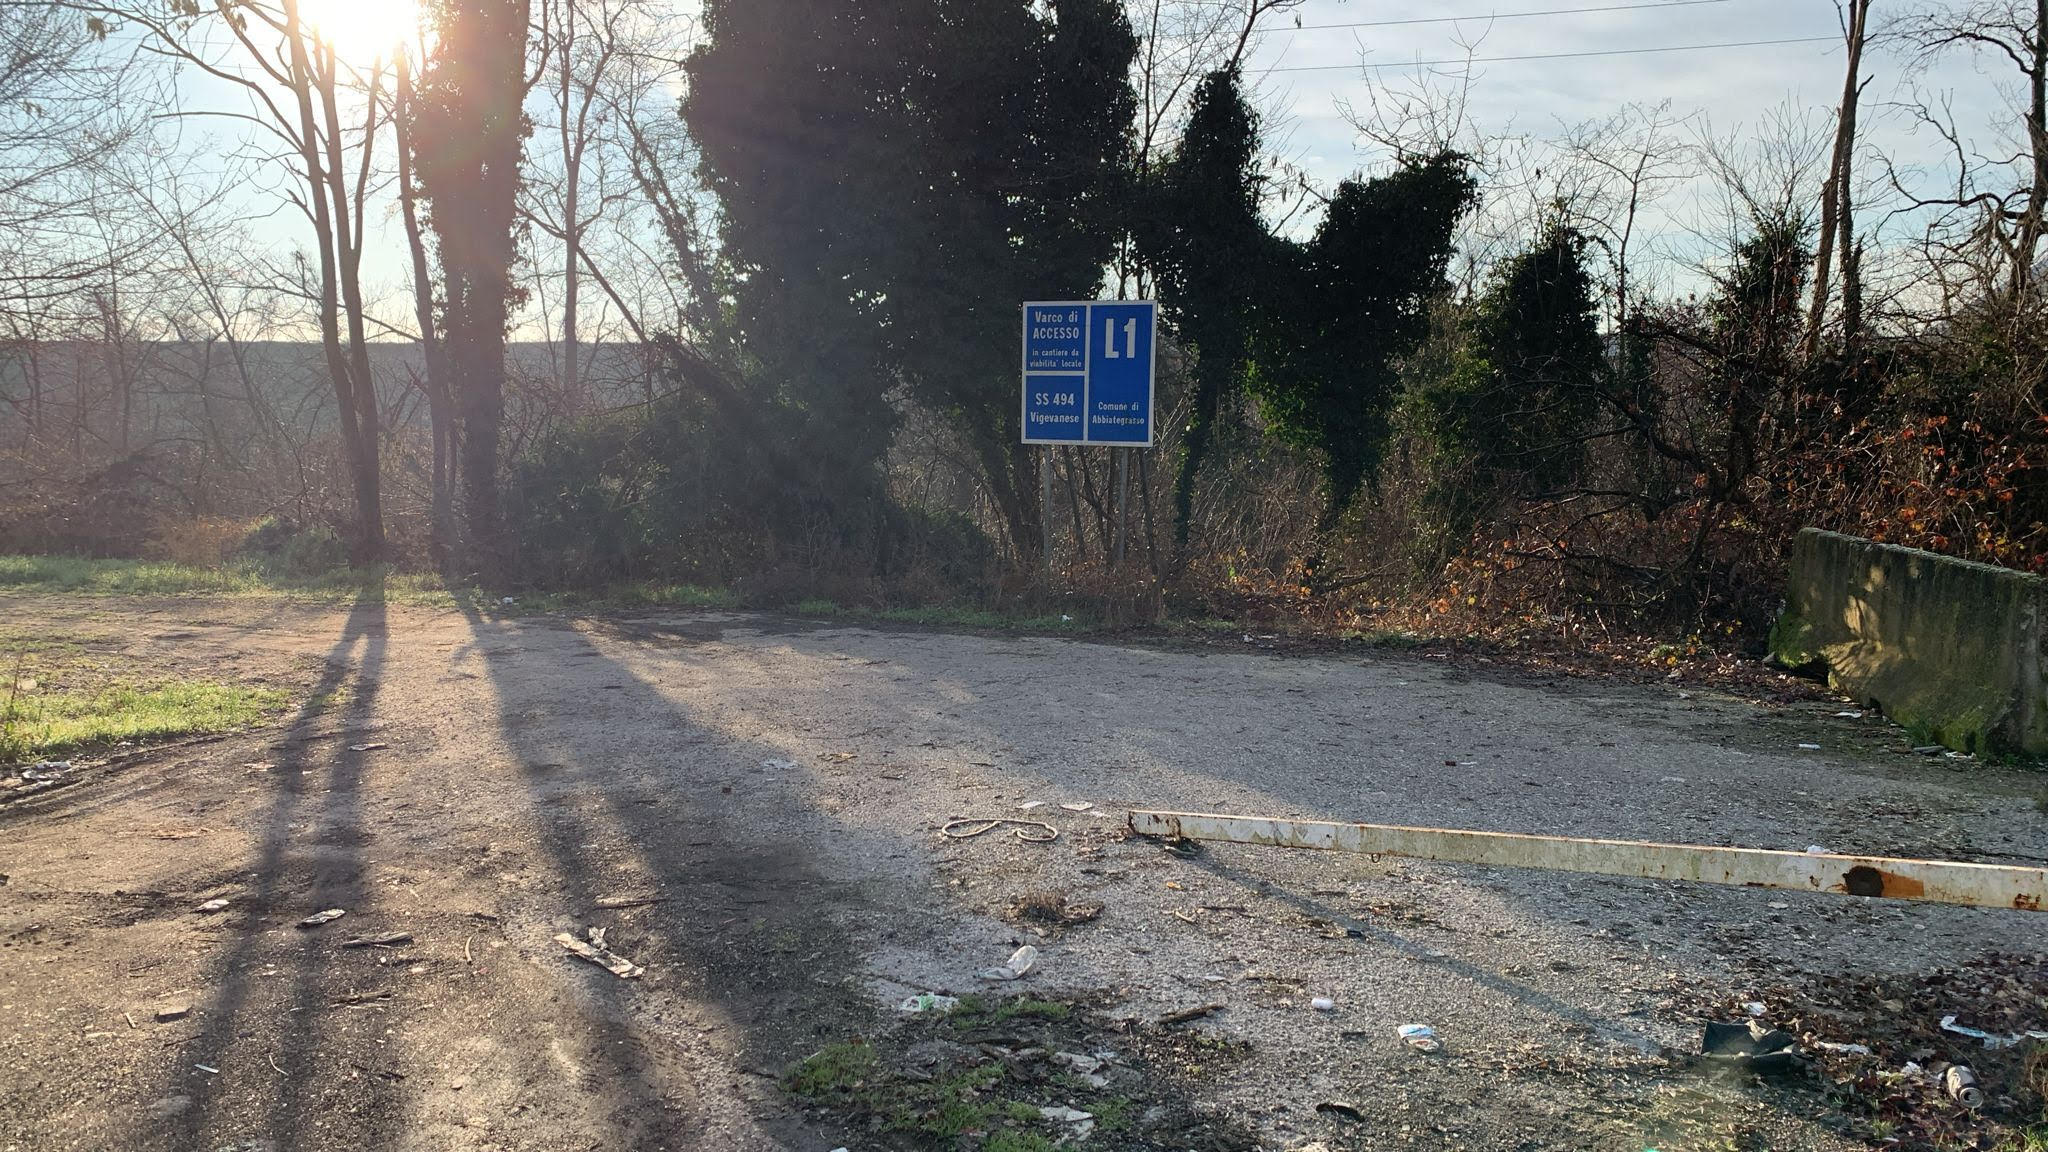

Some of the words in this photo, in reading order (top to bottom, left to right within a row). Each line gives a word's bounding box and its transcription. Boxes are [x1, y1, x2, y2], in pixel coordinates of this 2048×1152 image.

[1035, 311, 1063, 323] Varco
[1068, 310, 1078, 323] di
[1032, 327, 1080, 339] ACCESSO
[1104, 317, 1137, 359] L1
[1032, 348, 1039, 357] in
[1070, 348, 1079, 357] da
[1061, 359, 1082, 368] locale
[1035, 392, 1050, 406] SS
[1052, 392, 1075, 406] 494
[1098, 401, 1128, 411] Comune
[1131, 401, 1139, 411] di
[1030, 411, 1080, 425] Vigevanese
[1092, 414, 1145, 426] Abbiategrasso
